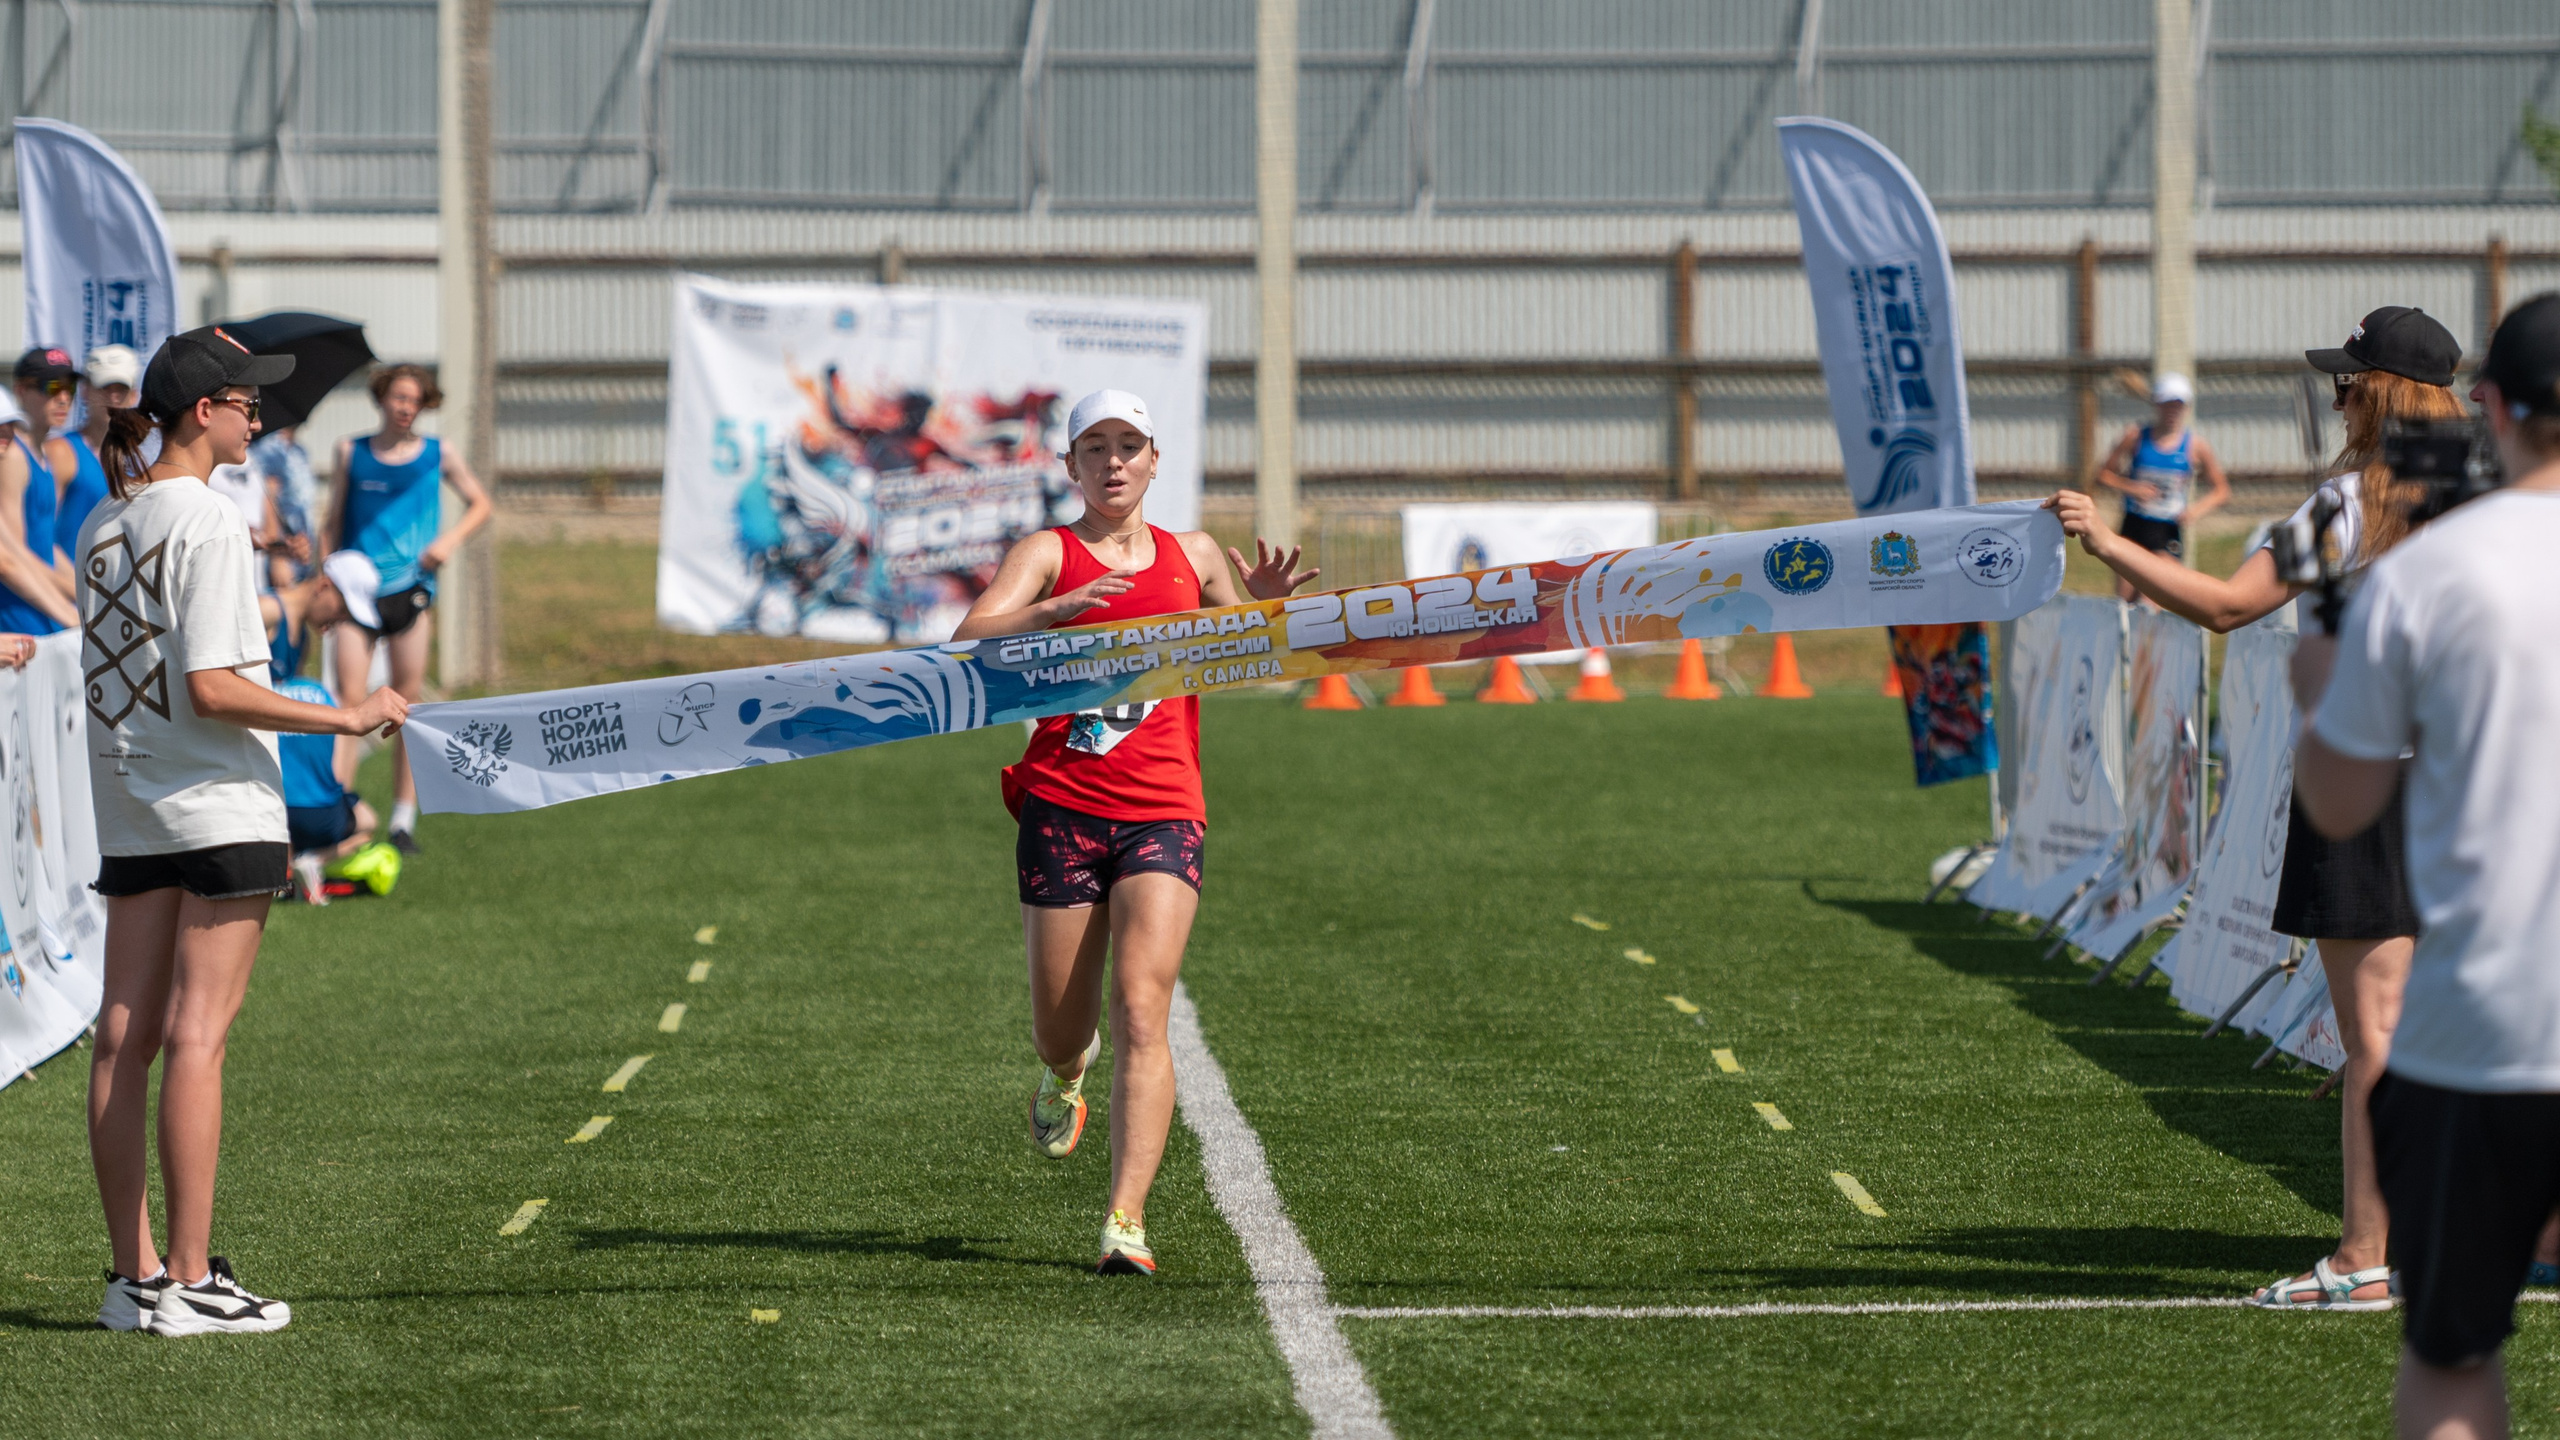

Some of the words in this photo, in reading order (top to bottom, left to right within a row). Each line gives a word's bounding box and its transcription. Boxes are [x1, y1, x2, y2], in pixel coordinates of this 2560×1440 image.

[1284, 567, 1539, 650] 2024
[1388, 605, 1538, 638] ЮНОШЕСКАЯ
[999, 610, 1267, 664] СПАРТАКИАДА
[1021, 652, 1160, 688] УЧАЩИХСЯ
[1171, 635, 1271, 665] РОССИИ
[1203, 659, 1283, 685] САМАРА
[538, 701, 605, 726] СПОРТ
[541, 714, 624, 746] НОРМА
[545, 733, 627, 766] ЖИЗНИ
